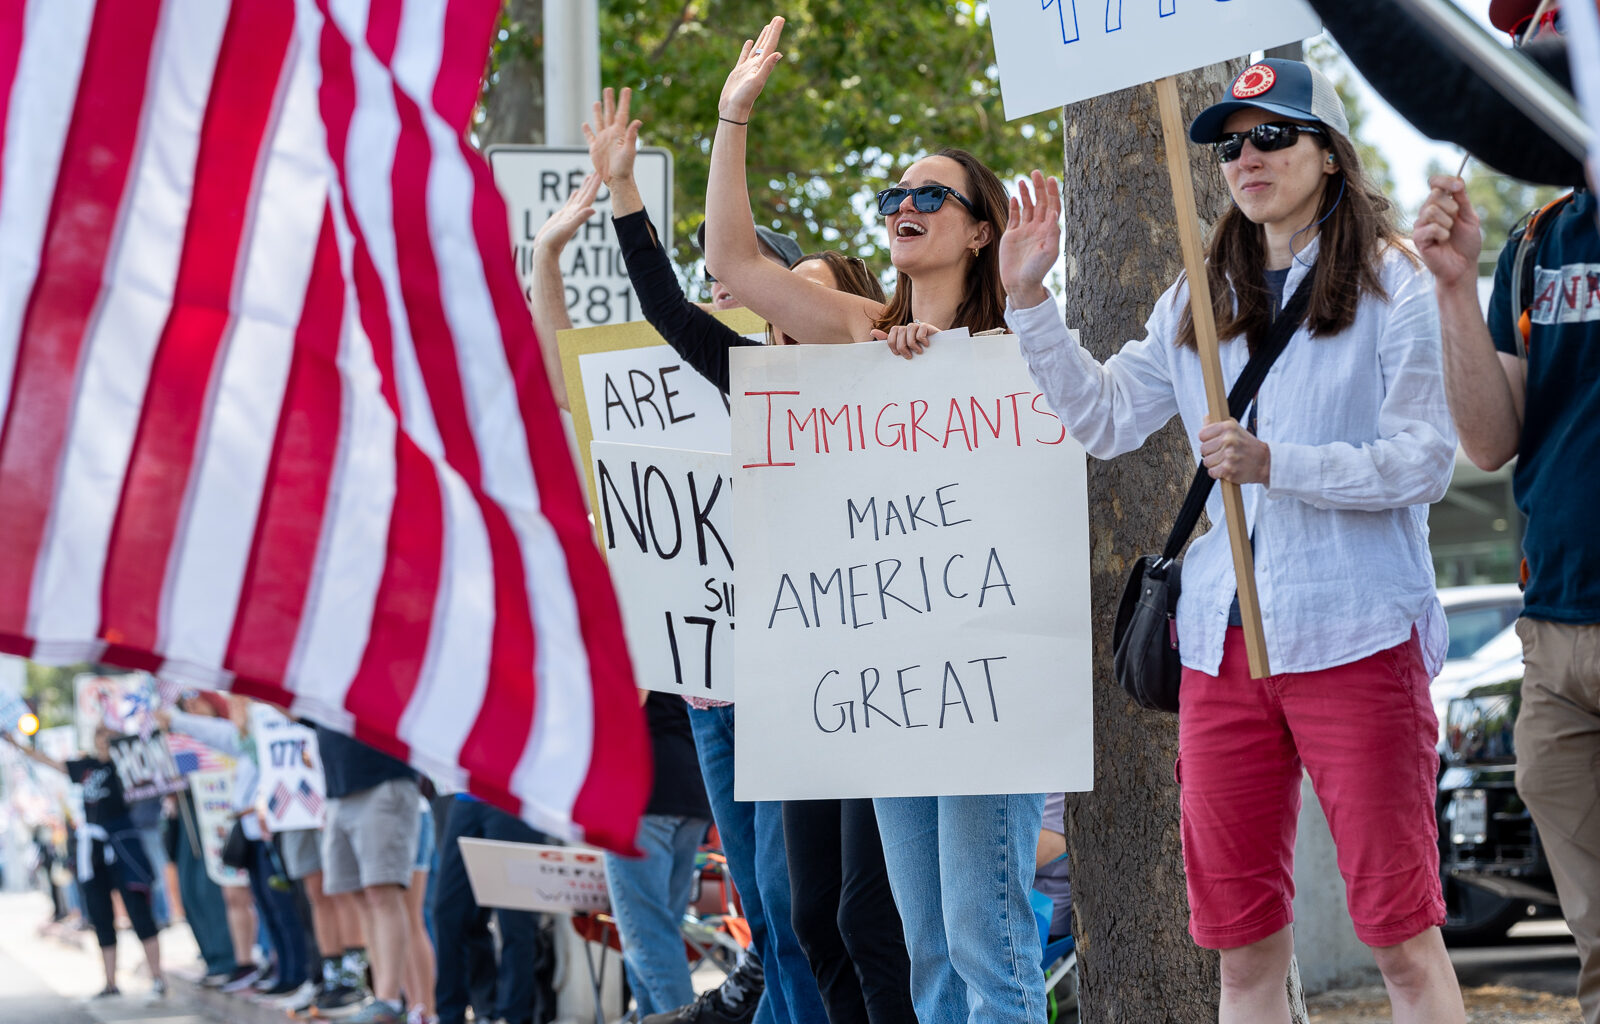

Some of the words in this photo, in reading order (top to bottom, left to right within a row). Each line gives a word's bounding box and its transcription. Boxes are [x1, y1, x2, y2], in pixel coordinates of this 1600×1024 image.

[527, 285, 632, 324] 281
[605, 365, 695, 431] ARE
[743, 391, 1066, 468] IMMIGRANTS
[687, 471, 733, 571] K
[848, 483, 971, 541] MAKE
[704, 577, 735, 617] SI
[768, 547, 1016, 629] AMERICA
[665, 611, 735, 689] 17
[814, 656, 1007, 733] GREAT
